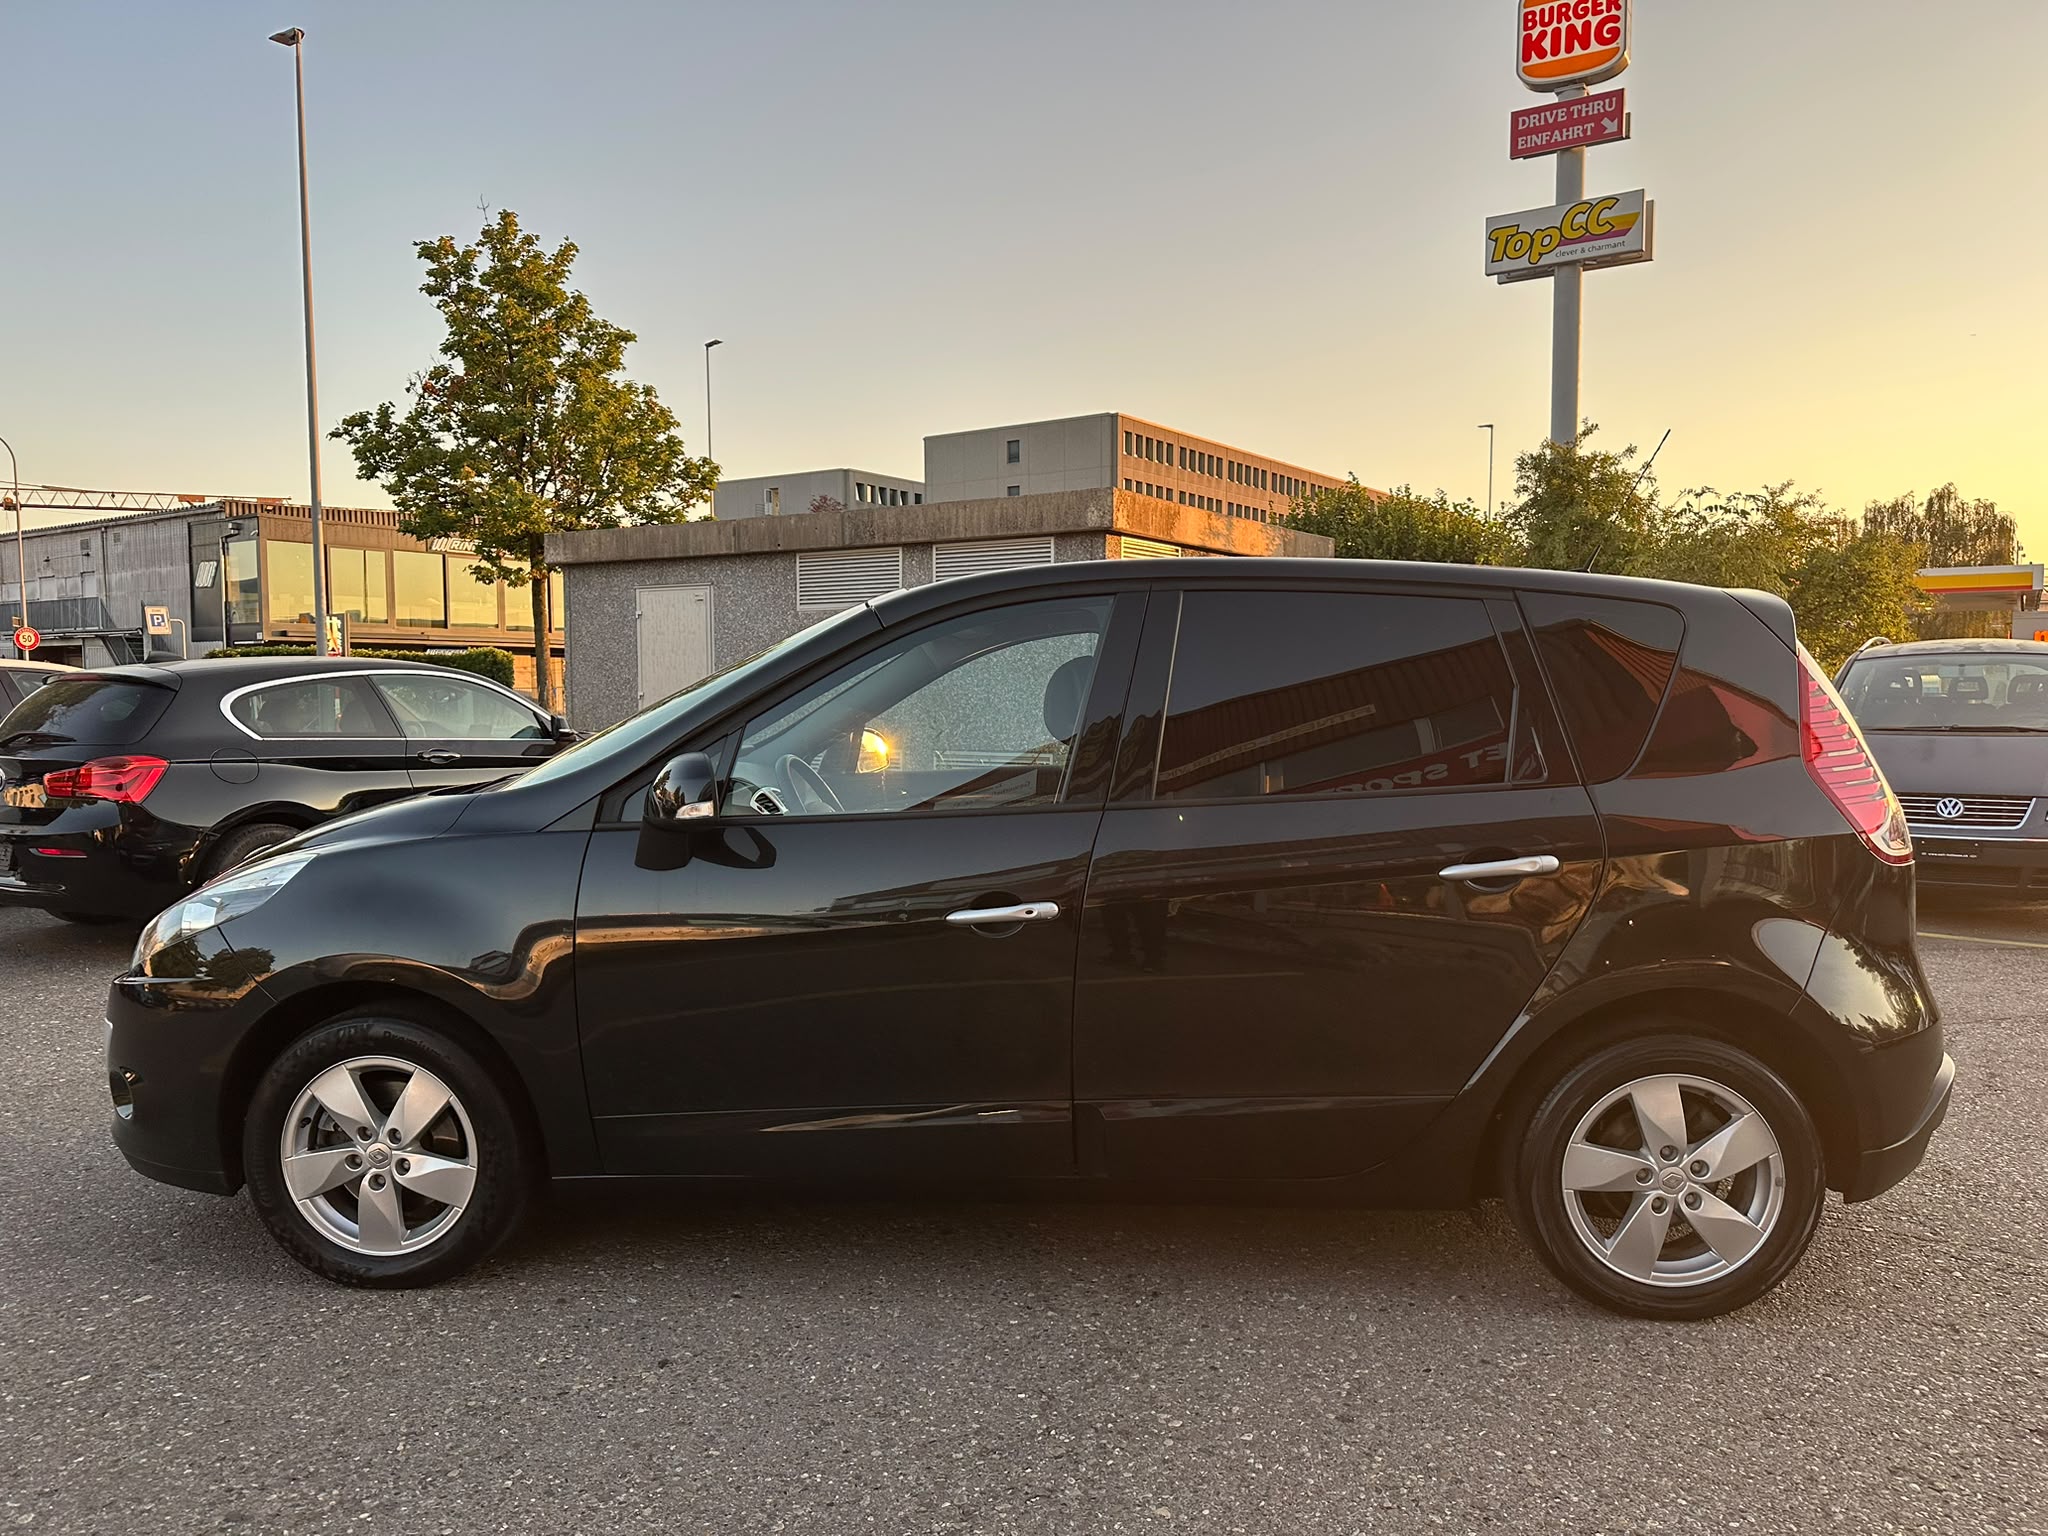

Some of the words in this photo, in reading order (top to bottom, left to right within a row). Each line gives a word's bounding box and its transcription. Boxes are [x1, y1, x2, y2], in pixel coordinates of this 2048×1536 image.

[1523, 0, 1622, 32] BURGER
[1522, 14, 1621, 63] KING
[1517, 103, 1567, 130] DRIVE
[1570, 97, 1617, 119] THRU
[1517, 122, 1595, 150] EINFAHRT
[1488, 197, 1620, 265] TopCC
[1555, 248, 1578, 258] clever
[1587, 240, 1626, 253] charmant
[22, 634, 32, 643] 50
